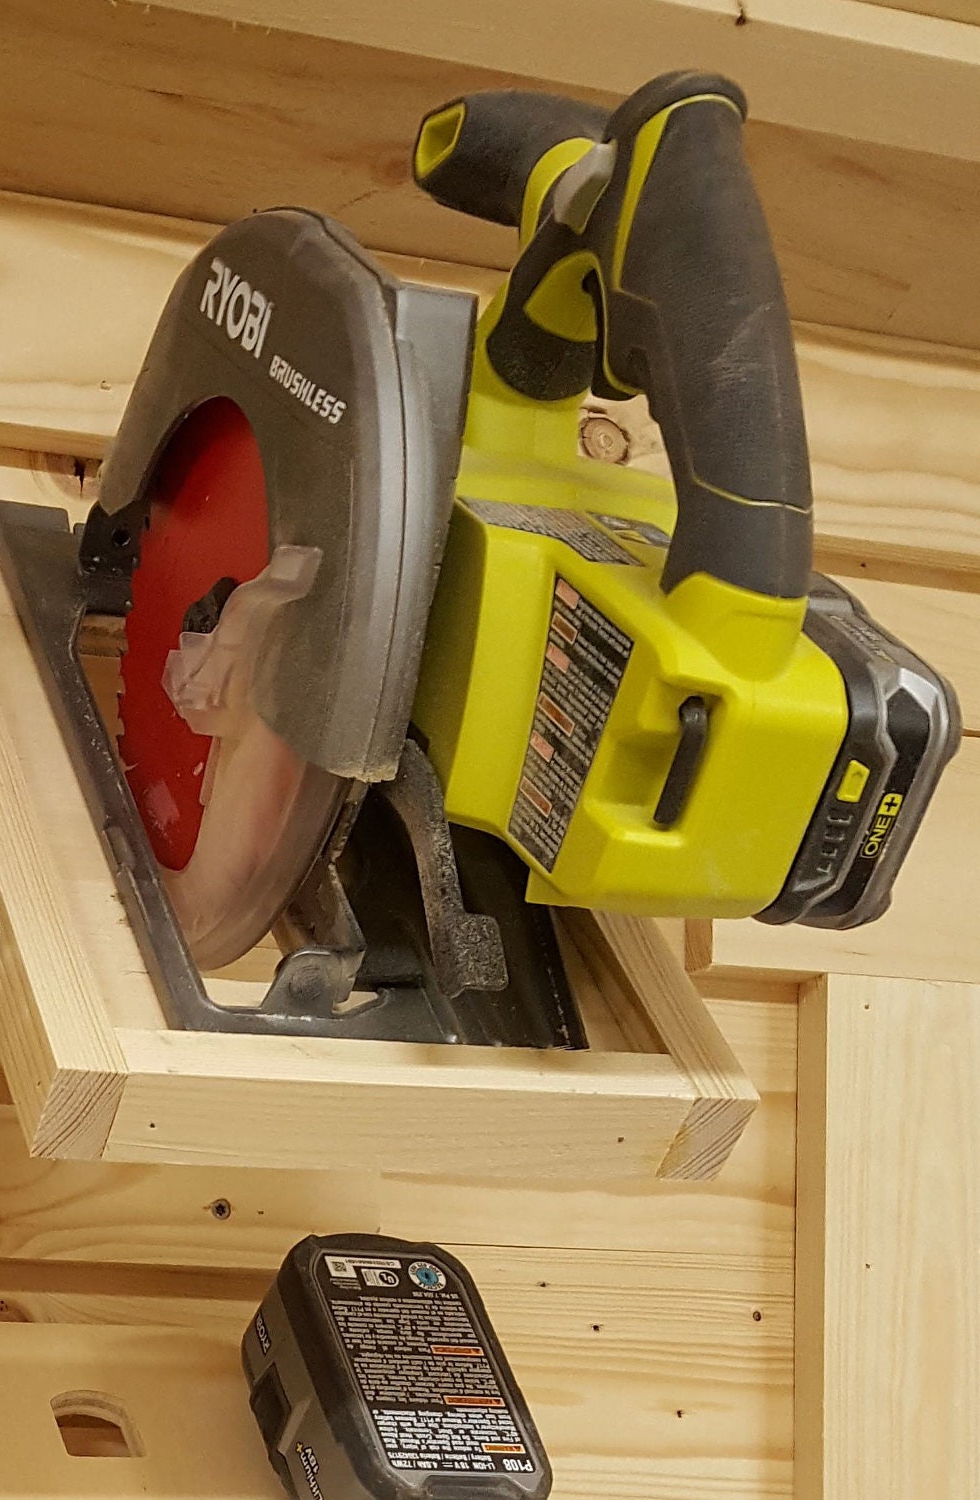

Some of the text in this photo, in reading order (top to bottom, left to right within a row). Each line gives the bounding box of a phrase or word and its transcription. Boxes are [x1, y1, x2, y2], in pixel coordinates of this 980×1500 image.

[200, 257, 347, 424] RYOBI BRUSHLESS
[864, 794, 903, 856] ONE+
[306, 1447, 319, 1474] 18V
[503, 1459, 533, 1471] P108
